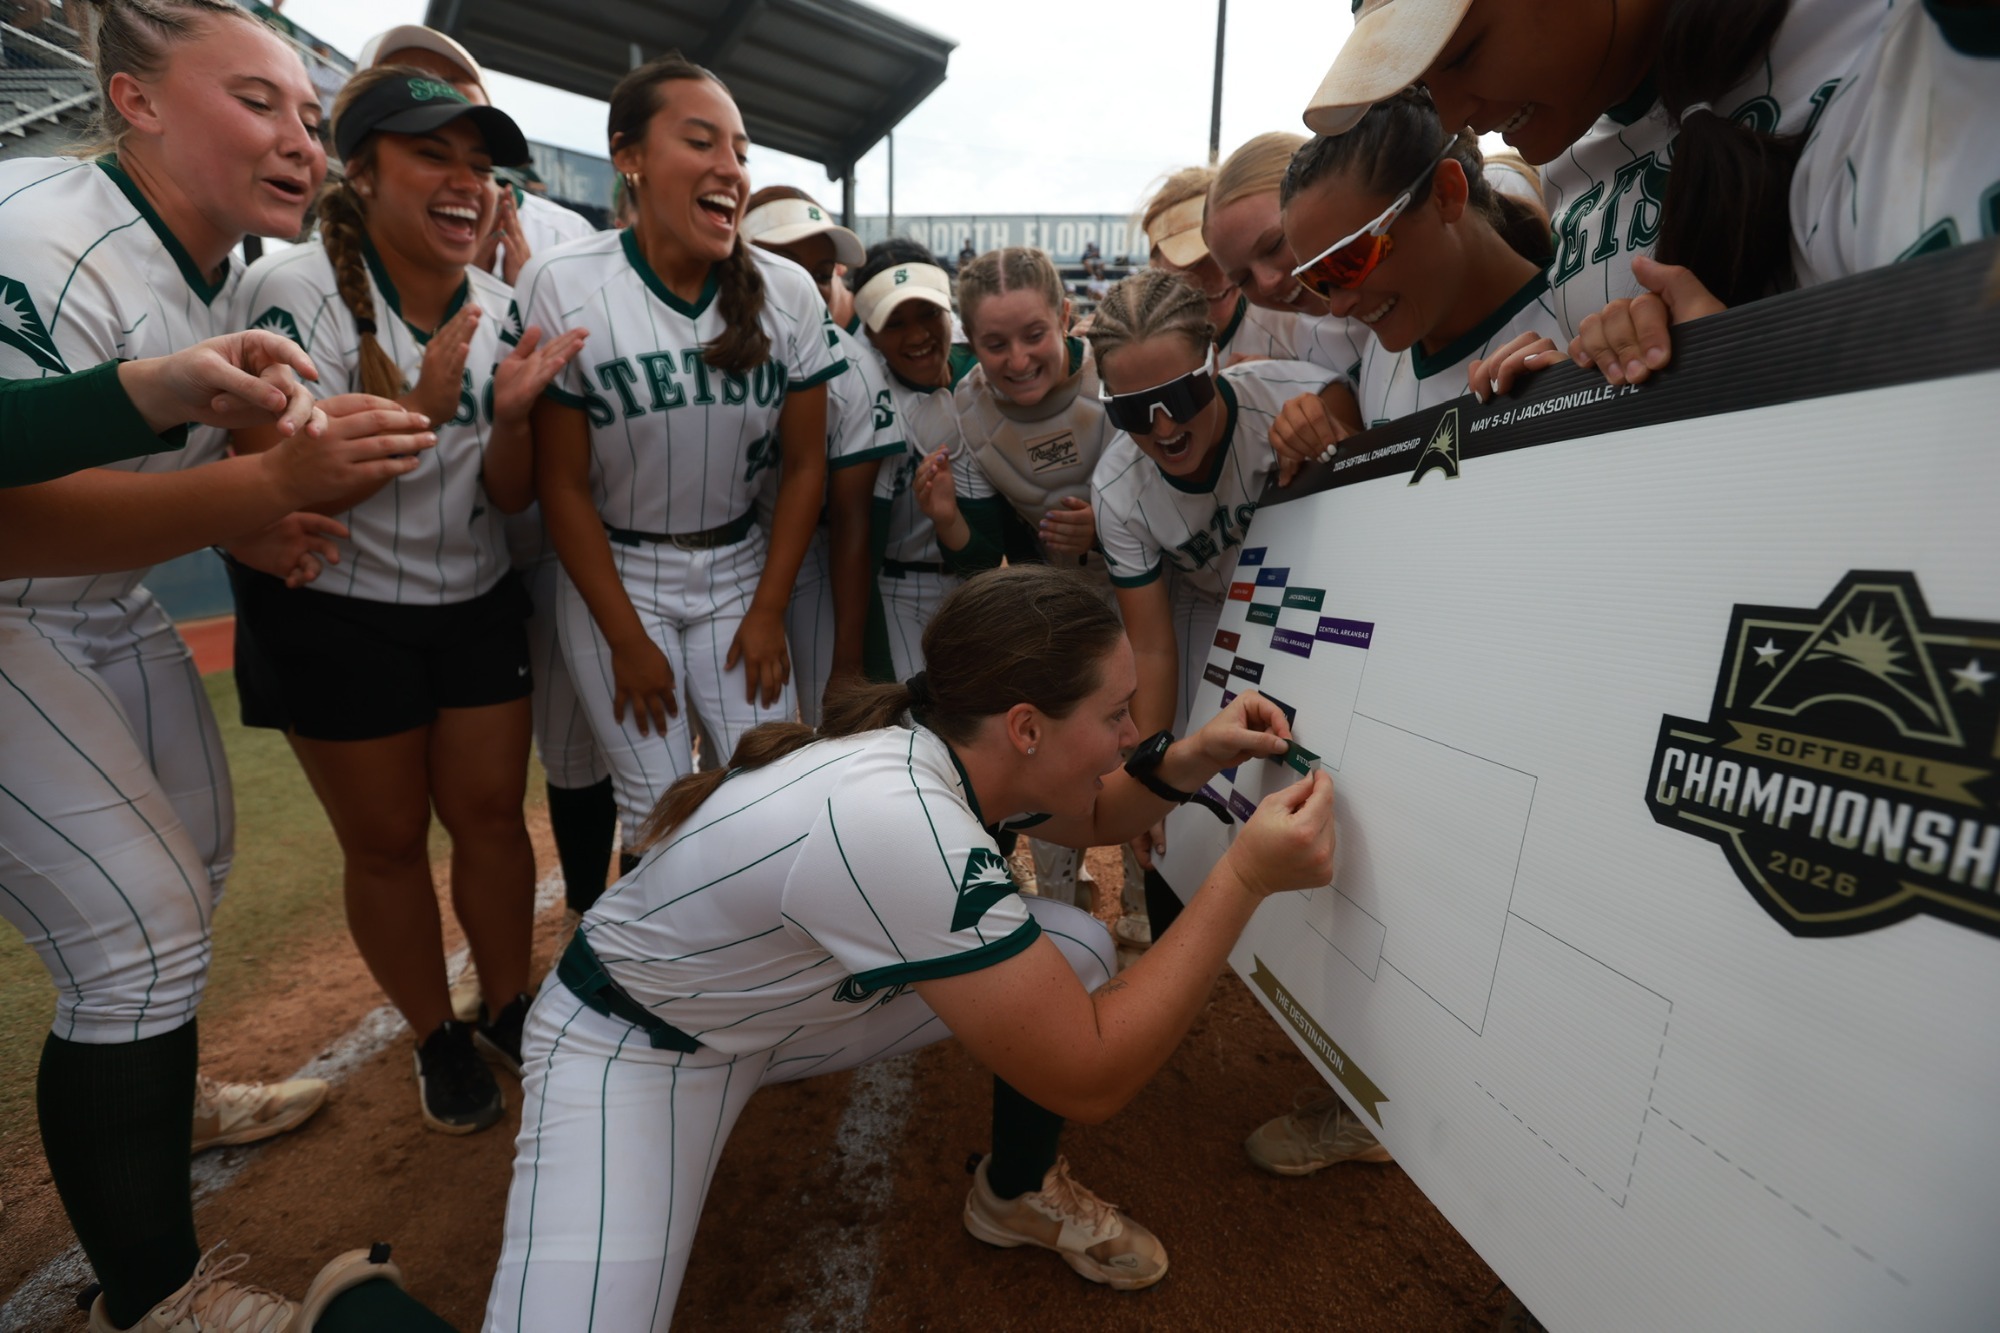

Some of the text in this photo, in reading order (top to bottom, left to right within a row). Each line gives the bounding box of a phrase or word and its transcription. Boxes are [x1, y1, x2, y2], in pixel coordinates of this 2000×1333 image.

[909, 221, 1010, 257] NORTH
[1470, 417, 1492, 433] MAY
[1492, 412, 1511, 427] 5-9
[1516, 384, 1617, 421] JACKSONVILLE,
[1620, 383, 1640, 397] FL
[1345, 452, 1371, 468] SOFTBALL
[1371, 437, 1421, 460] CHAMPIONSHIP
[1288, 594, 1317, 603] JACKSONVILLE
[1273, 635, 1311, 650] CENTRAL ARKANSAS
[1318, 625, 1369, 639] CENTRAL ARKANSAS
[1295, 754, 1311, 768] STETS
[1755, 732, 1937, 789] SOFTBALL
[1655, 747, 2000, 892] CHAMPIONSH
[1766, 850, 1859, 897] 2026
[1275, 988, 1345, 1075] THE DESTINATION.
